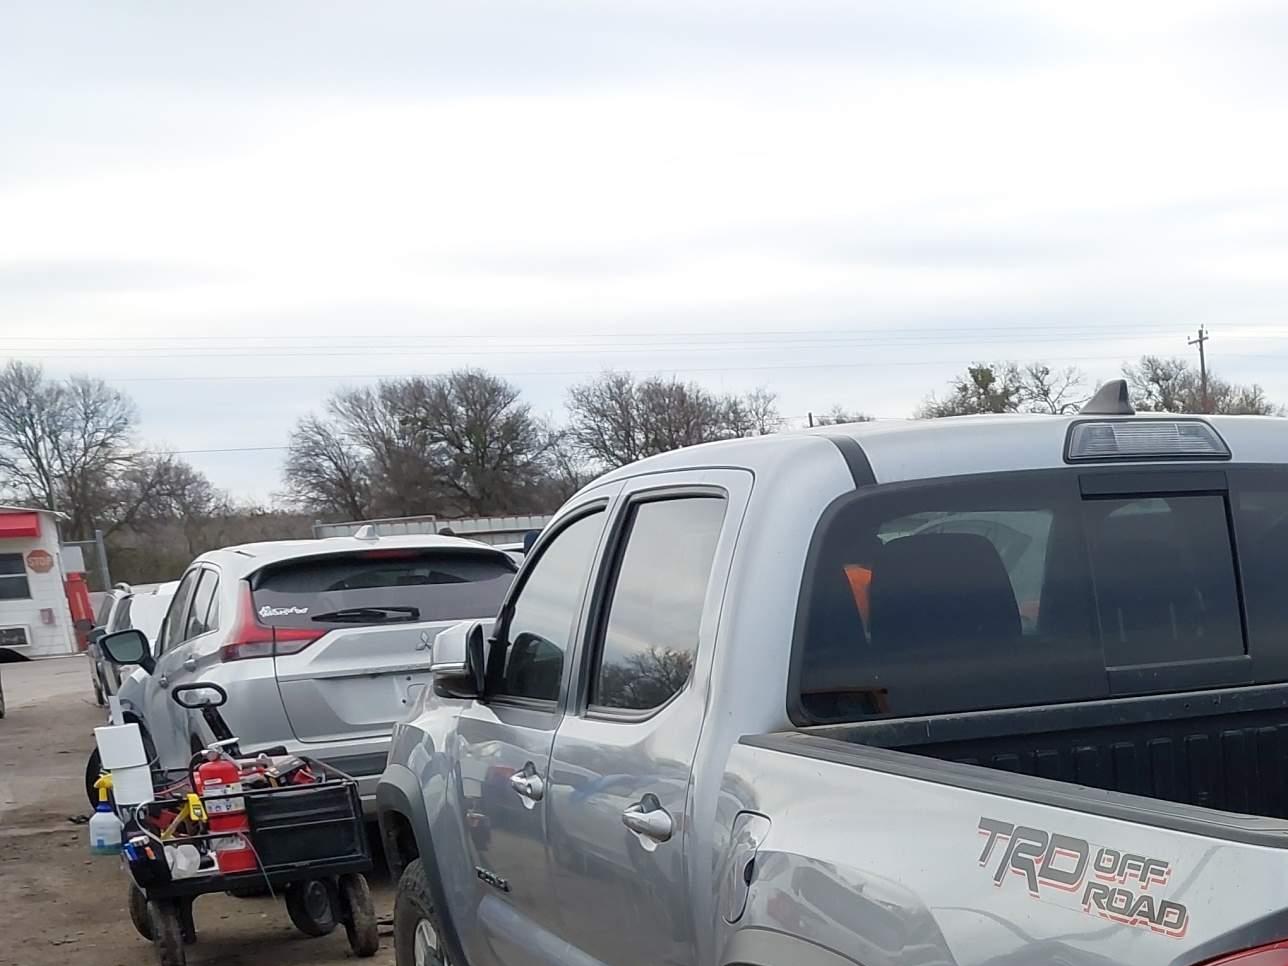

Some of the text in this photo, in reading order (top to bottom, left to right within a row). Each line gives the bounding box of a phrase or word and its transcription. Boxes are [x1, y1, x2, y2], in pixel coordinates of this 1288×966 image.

[978, 816, 1172, 898] TRD OFF
[1081, 880, 1189, 940] ROAD
